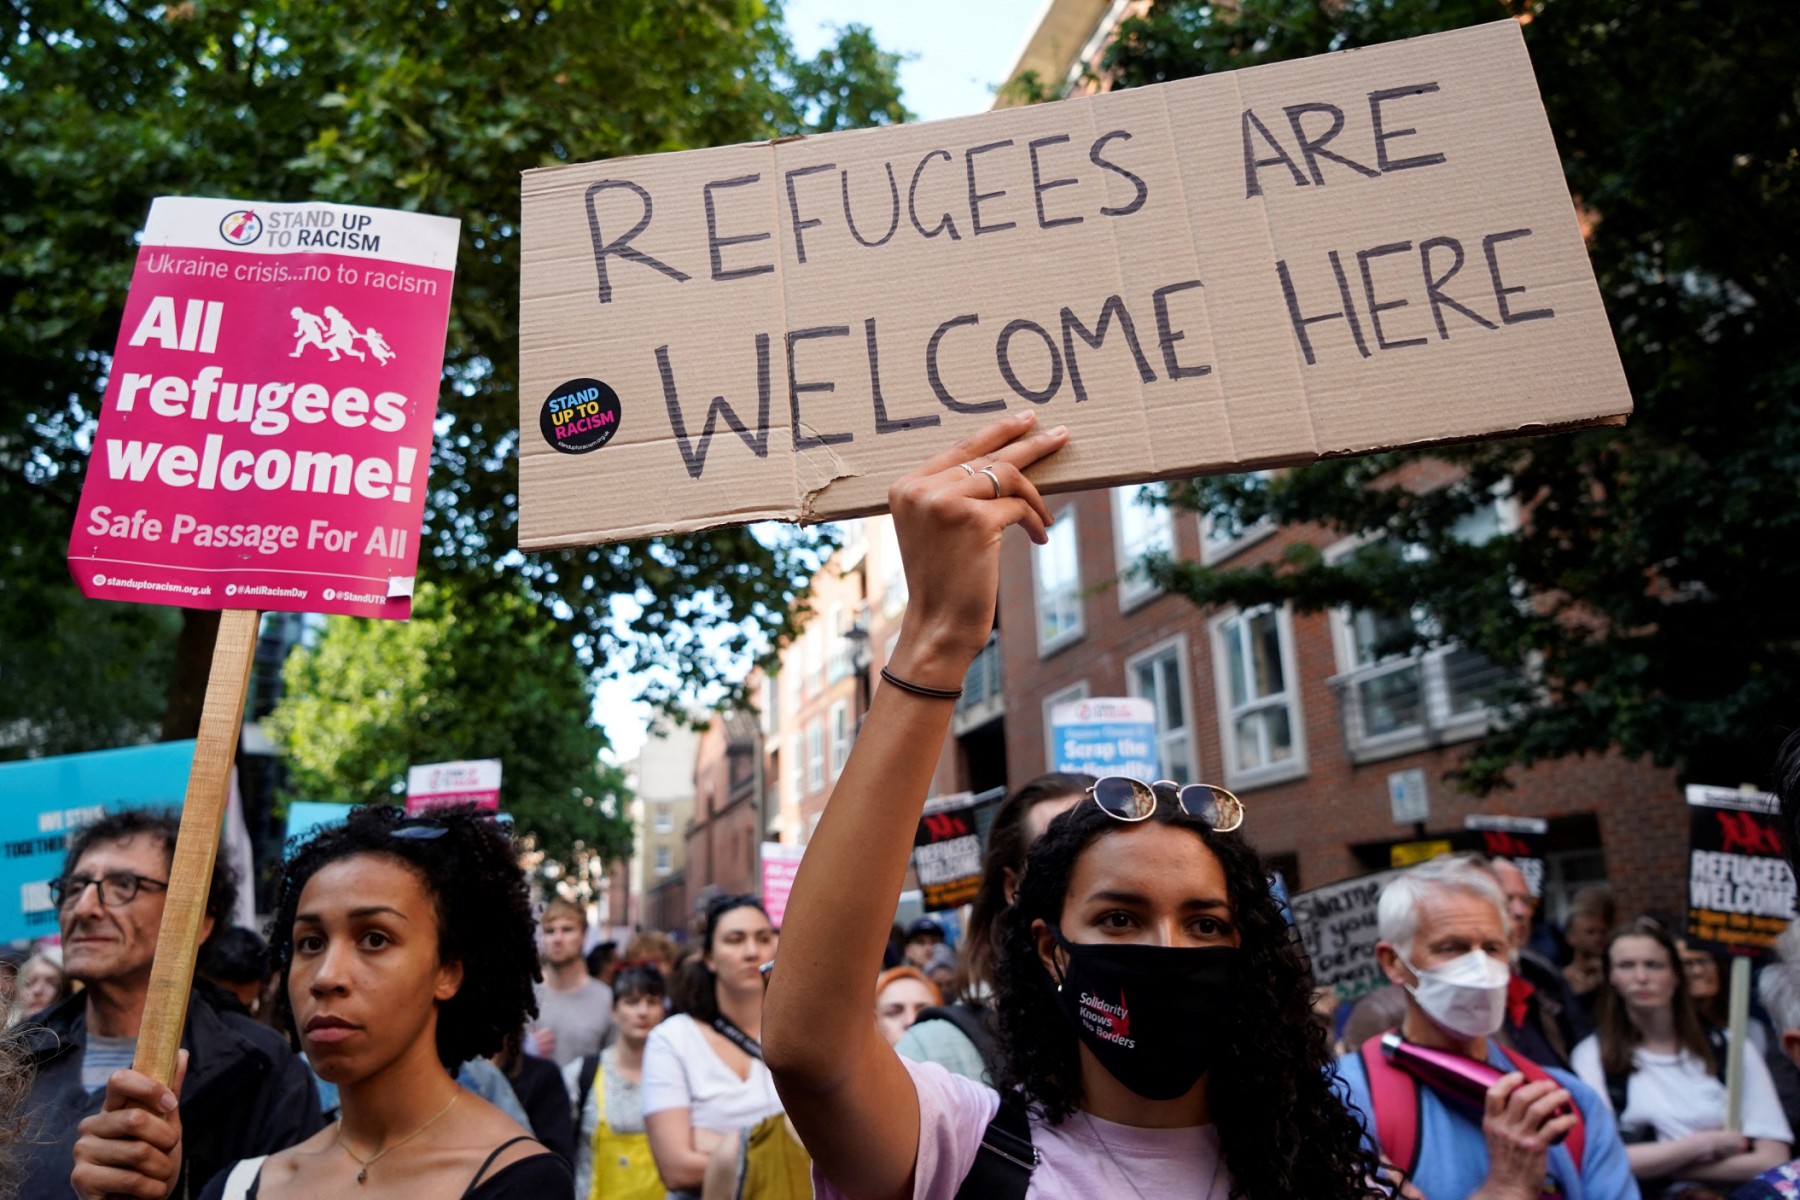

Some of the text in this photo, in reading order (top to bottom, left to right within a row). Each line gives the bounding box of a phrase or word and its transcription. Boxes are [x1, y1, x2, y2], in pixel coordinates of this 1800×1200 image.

[585, 81, 1446, 303] REFUGEES ARE
[268, 210, 372, 232] STAND UP
[266, 229, 381, 253] TO RACISM
[147, 253, 438, 296] Ukraine crisis...no to racism
[128, 295, 225, 354] All
[654, 228, 1555, 479] WELCOME HERE
[115, 366, 409, 436] refugees
[549, 387, 600, 413] STAND
[551, 401, 600, 426] UP TO
[555, 409, 615, 440] RACISM
[106, 433, 418, 503] welcome!
[86, 505, 407, 560] Safe Passage For All
[107, 576, 212, 596] standuptoracism.org.uk
[237, 583, 308, 600] @AntiRacismDay
[1064, 738, 1148, 762] Scrap the
[1690, 880, 1799, 919] WELCOME
[1079, 992, 1128, 1020] Solidarity
[1079, 1006, 1113, 1027] Knows
[1082, 1019, 1136, 1049] No Borders
